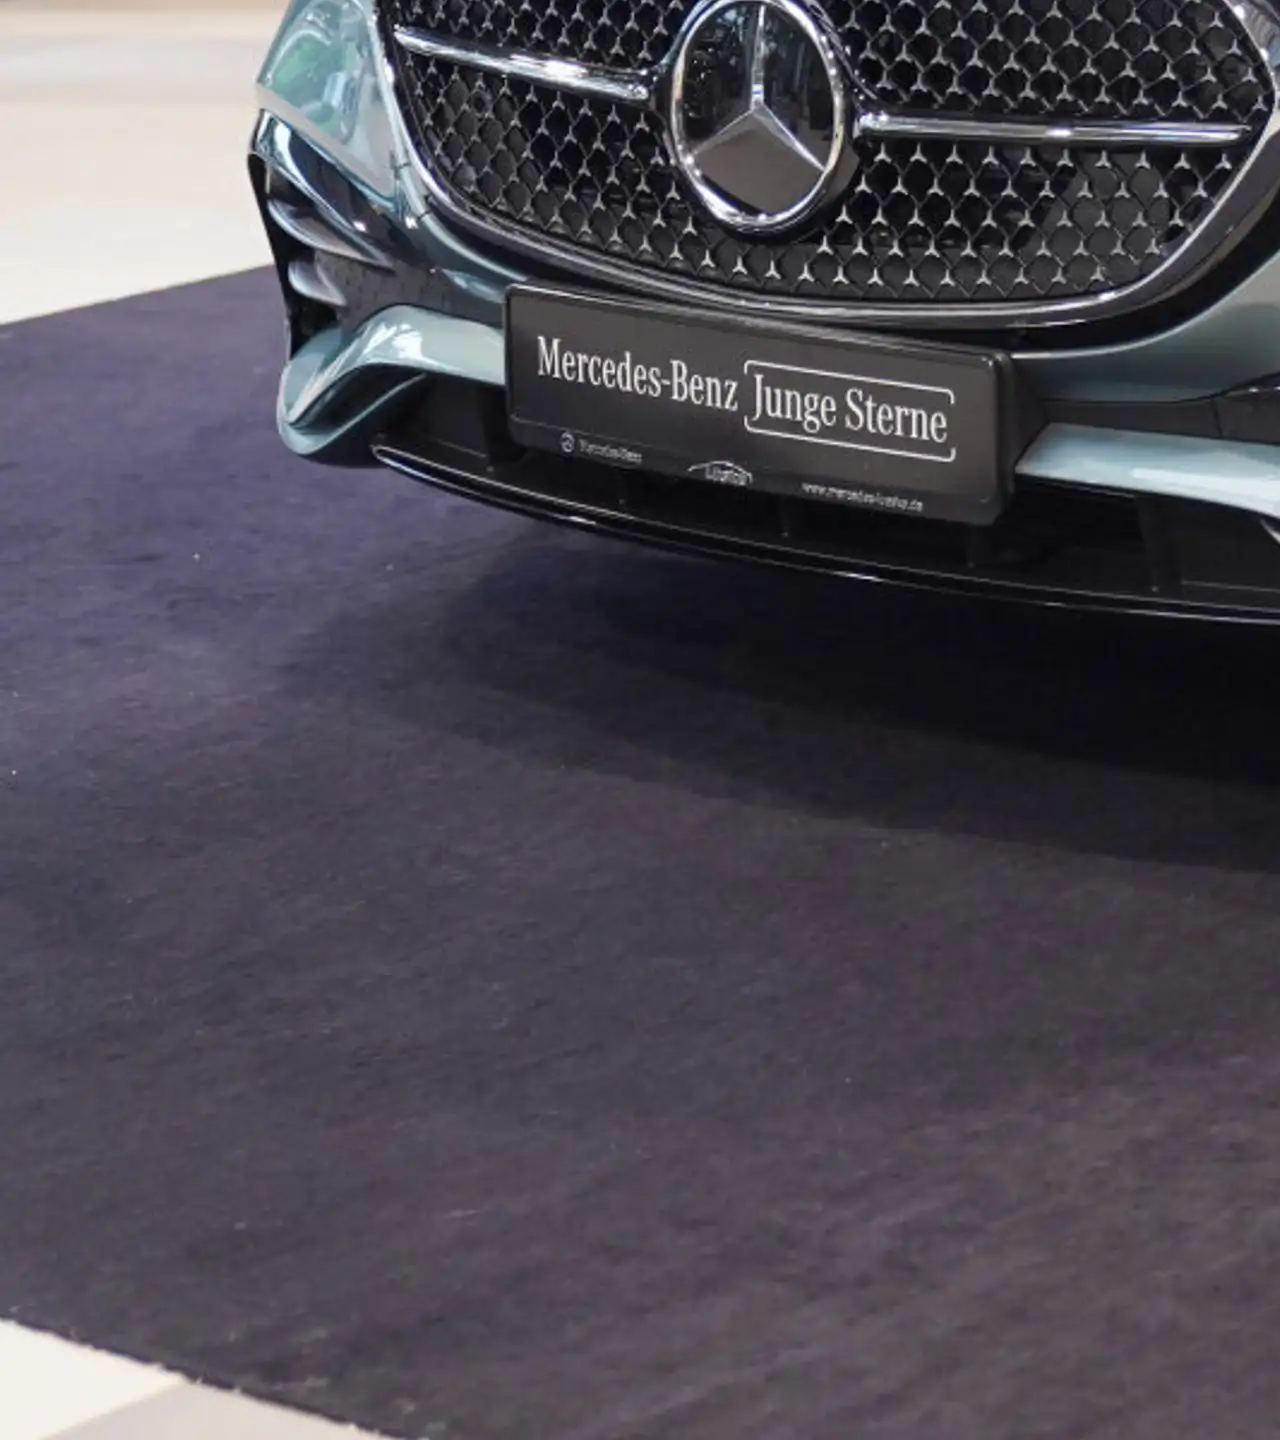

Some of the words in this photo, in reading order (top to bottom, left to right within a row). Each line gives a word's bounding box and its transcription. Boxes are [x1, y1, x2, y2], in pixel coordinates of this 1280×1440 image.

[537, 335, 739, 411] Mercedes-Benz
[752, 373, 837, 434] Junge
[844, 387, 948, 444] Sterne
